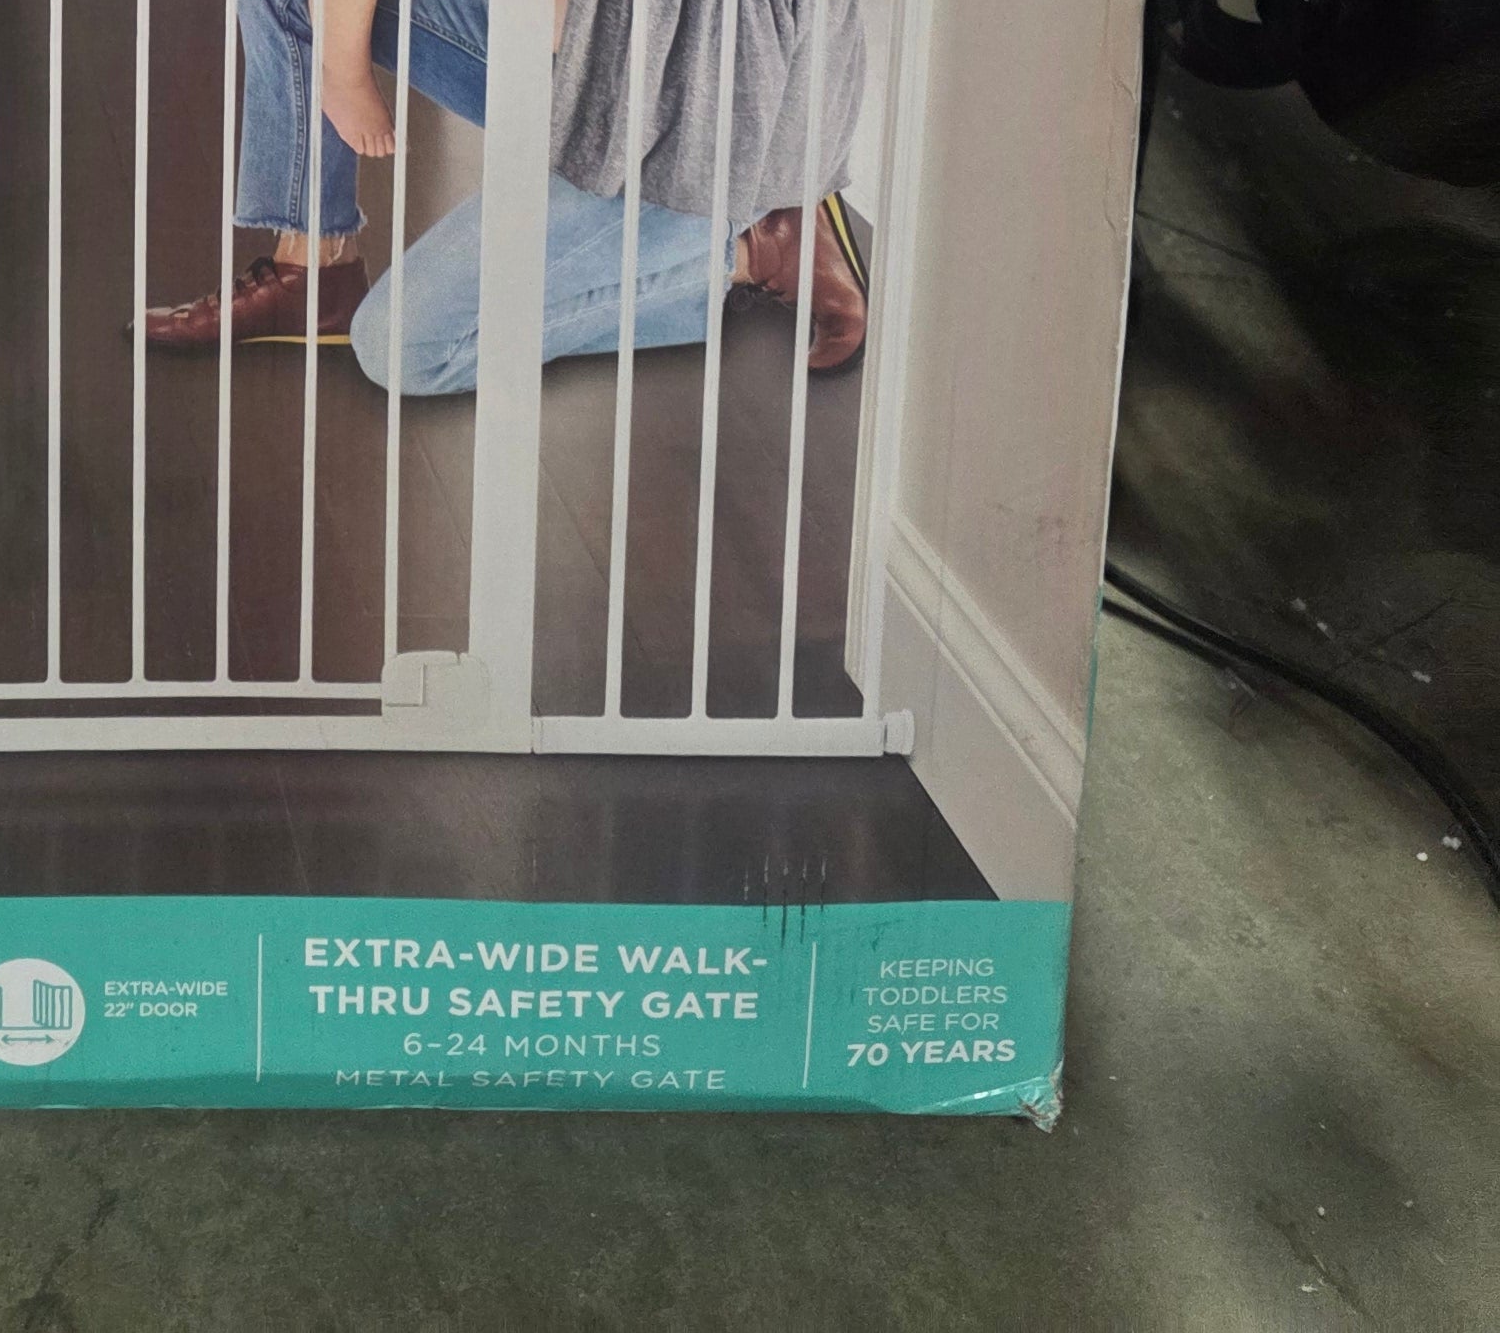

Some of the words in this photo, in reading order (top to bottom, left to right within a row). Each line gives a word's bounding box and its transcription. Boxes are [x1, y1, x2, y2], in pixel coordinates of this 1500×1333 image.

[304, 937, 599, 974] EXTRA-WIDE
[618, 945, 768, 975] WALK-
[879, 957, 995, 979] KEEPING
[104, 980, 229, 997] EXTRA-WIDE
[861, 985, 1008, 1007] TODDLERS
[139, 1002, 199, 1018] DOOR
[308, 985, 430, 1015] THRU
[449, 986, 624, 1020] SAFETY
[641, 990, 760, 1020] GATE
[866, 1014, 940, 1034] SAFE
[944, 1012, 1000, 1032] FOR
[402, 1034, 488, 1057] 6-24
[504, 1034, 661, 1058] MONTHS
[846, 1042, 890, 1067] 70
[901, 1039, 1016, 1065] YEARS
[335, 1069, 455, 1088] METAL
[472, 1070, 613, 1090] SAFETY
[630, 1069, 727, 1090] GATE
